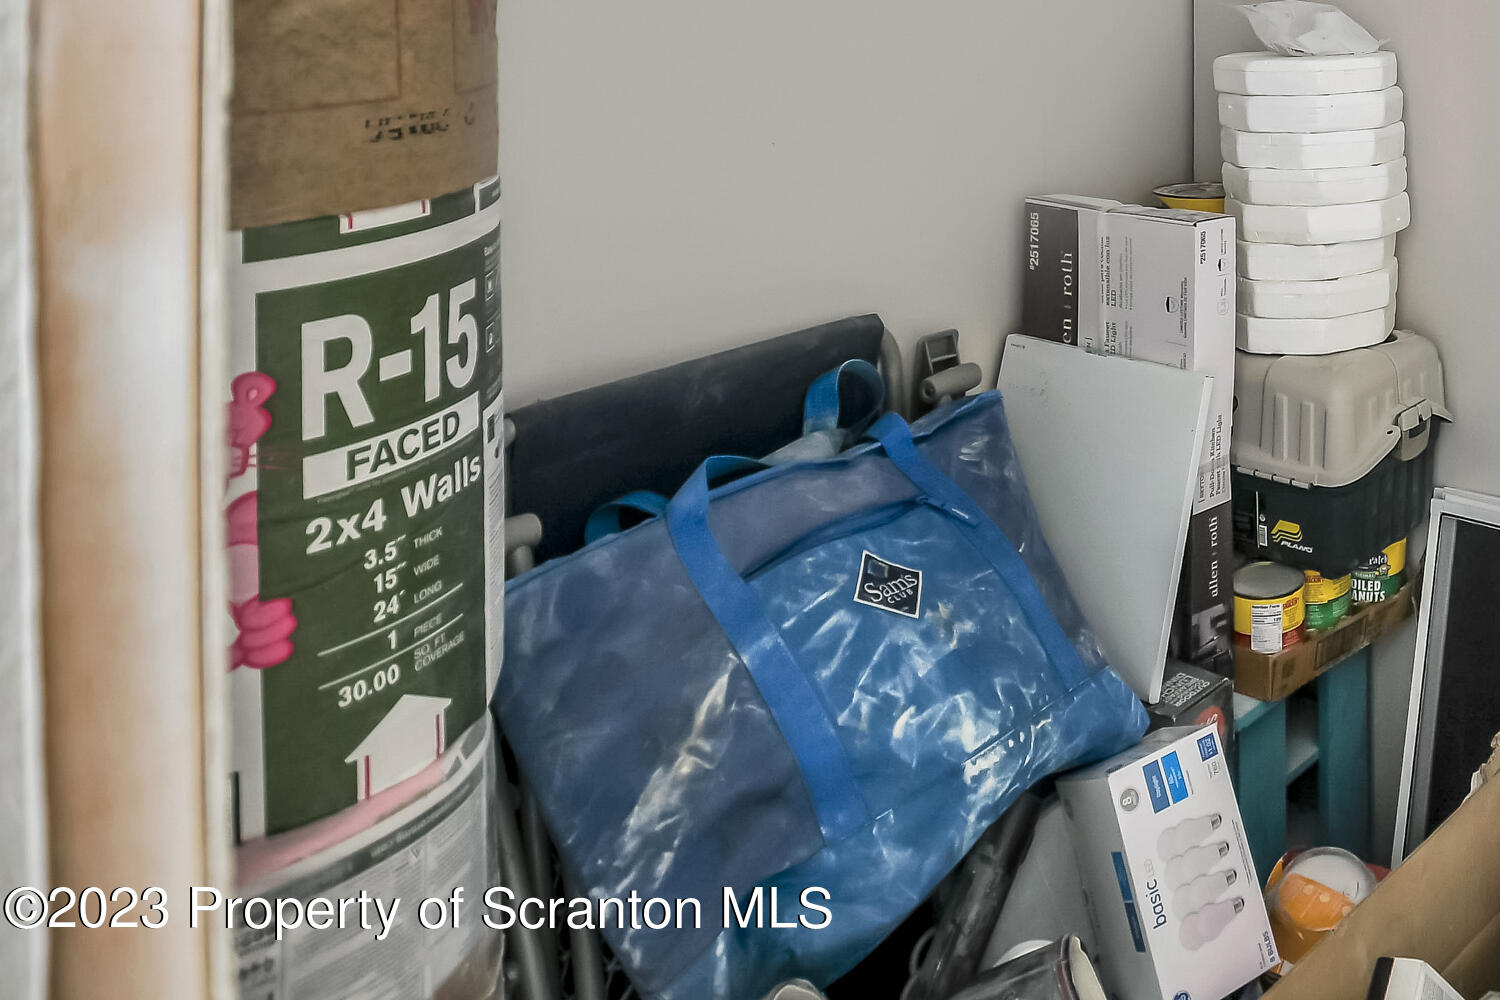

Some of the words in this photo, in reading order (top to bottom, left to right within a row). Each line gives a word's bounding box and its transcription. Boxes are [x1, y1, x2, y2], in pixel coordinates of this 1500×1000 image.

[1029, 211, 1039, 271] #2517065
[1060, 253, 1073, 296] roth
[301, 277, 478, 441] R-15
[347, 411, 460, 481] FACED
[305, 498, 387, 554] 2x4
[401, 455, 481, 517] Walls
[414, 526, 443, 549] THICK
[1208, 516, 1218, 547] roth
[1280, 540, 1314, 553] PLANO
[413, 554, 440, 576] WIDE
[1208, 560, 1218, 597] allen
[414, 580, 442, 604] LONG
[887, 588, 913, 604] CLUB
[1351, 578, 1381, 592] OILED
[1351, 590, 1386, 603] ANUTS
[387, 630, 397, 649] 1
[414, 613, 442, 638] PIECE
[414, 631, 465, 671] COVERAGE
[338, 664, 399, 707] 30.00
[1122, 796, 1132, 806] 8
[1145, 879, 1167, 929] basic
